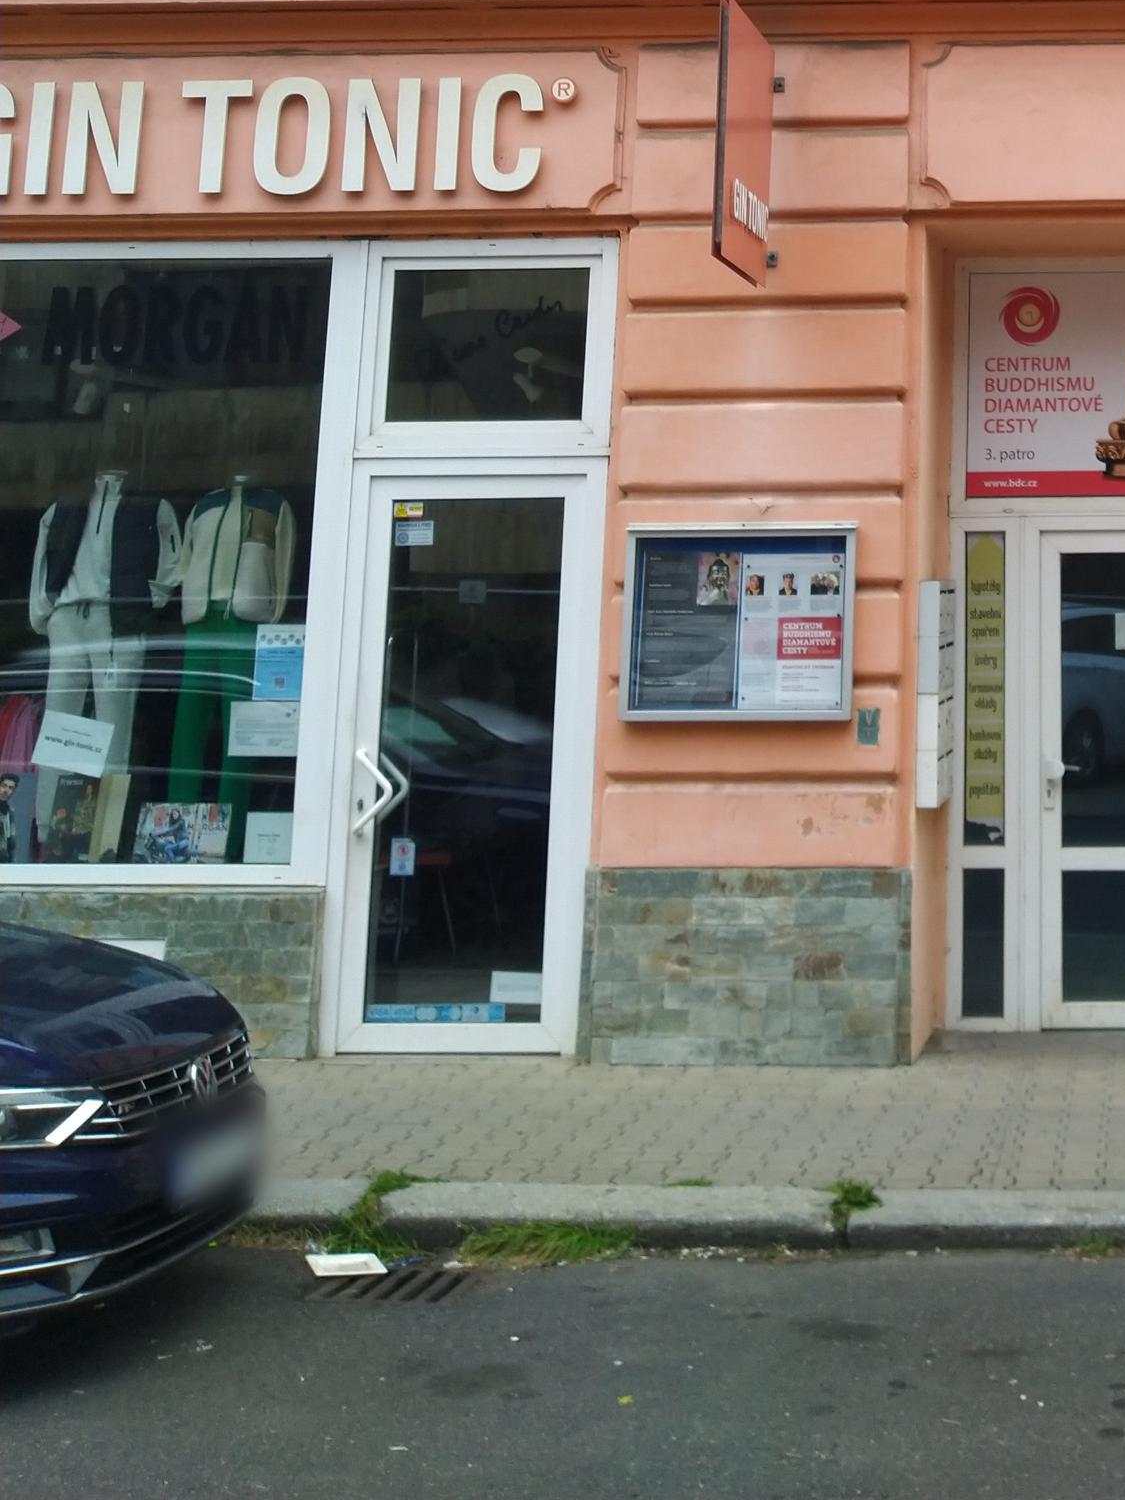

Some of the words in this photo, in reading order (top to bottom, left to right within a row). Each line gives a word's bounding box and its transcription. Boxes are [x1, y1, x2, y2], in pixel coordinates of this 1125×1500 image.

[0, 80, 145, 196] IN
[733, 178, 748, 225] GIN
[748, 191, 769, 243] TONIC
[41, 284, 309, 366] MORGAN
[984, 357, 1071, 373] CENTRUM
[984, 376, 1095, 393] BUDDHISMU
[983, 394, 1104, 413] DIAMANTOVÉ
[983, 418, 1039, 434] CESTY
[984, 448, 997, 461] 3.
[999, 448, 1036, 463] patro
[983, 478, 1039, 489] www.bdc.cz
[782, 621, 824, 630] CENTRUM
[44, 734, 103, 754] www.gin-tonic.cz
